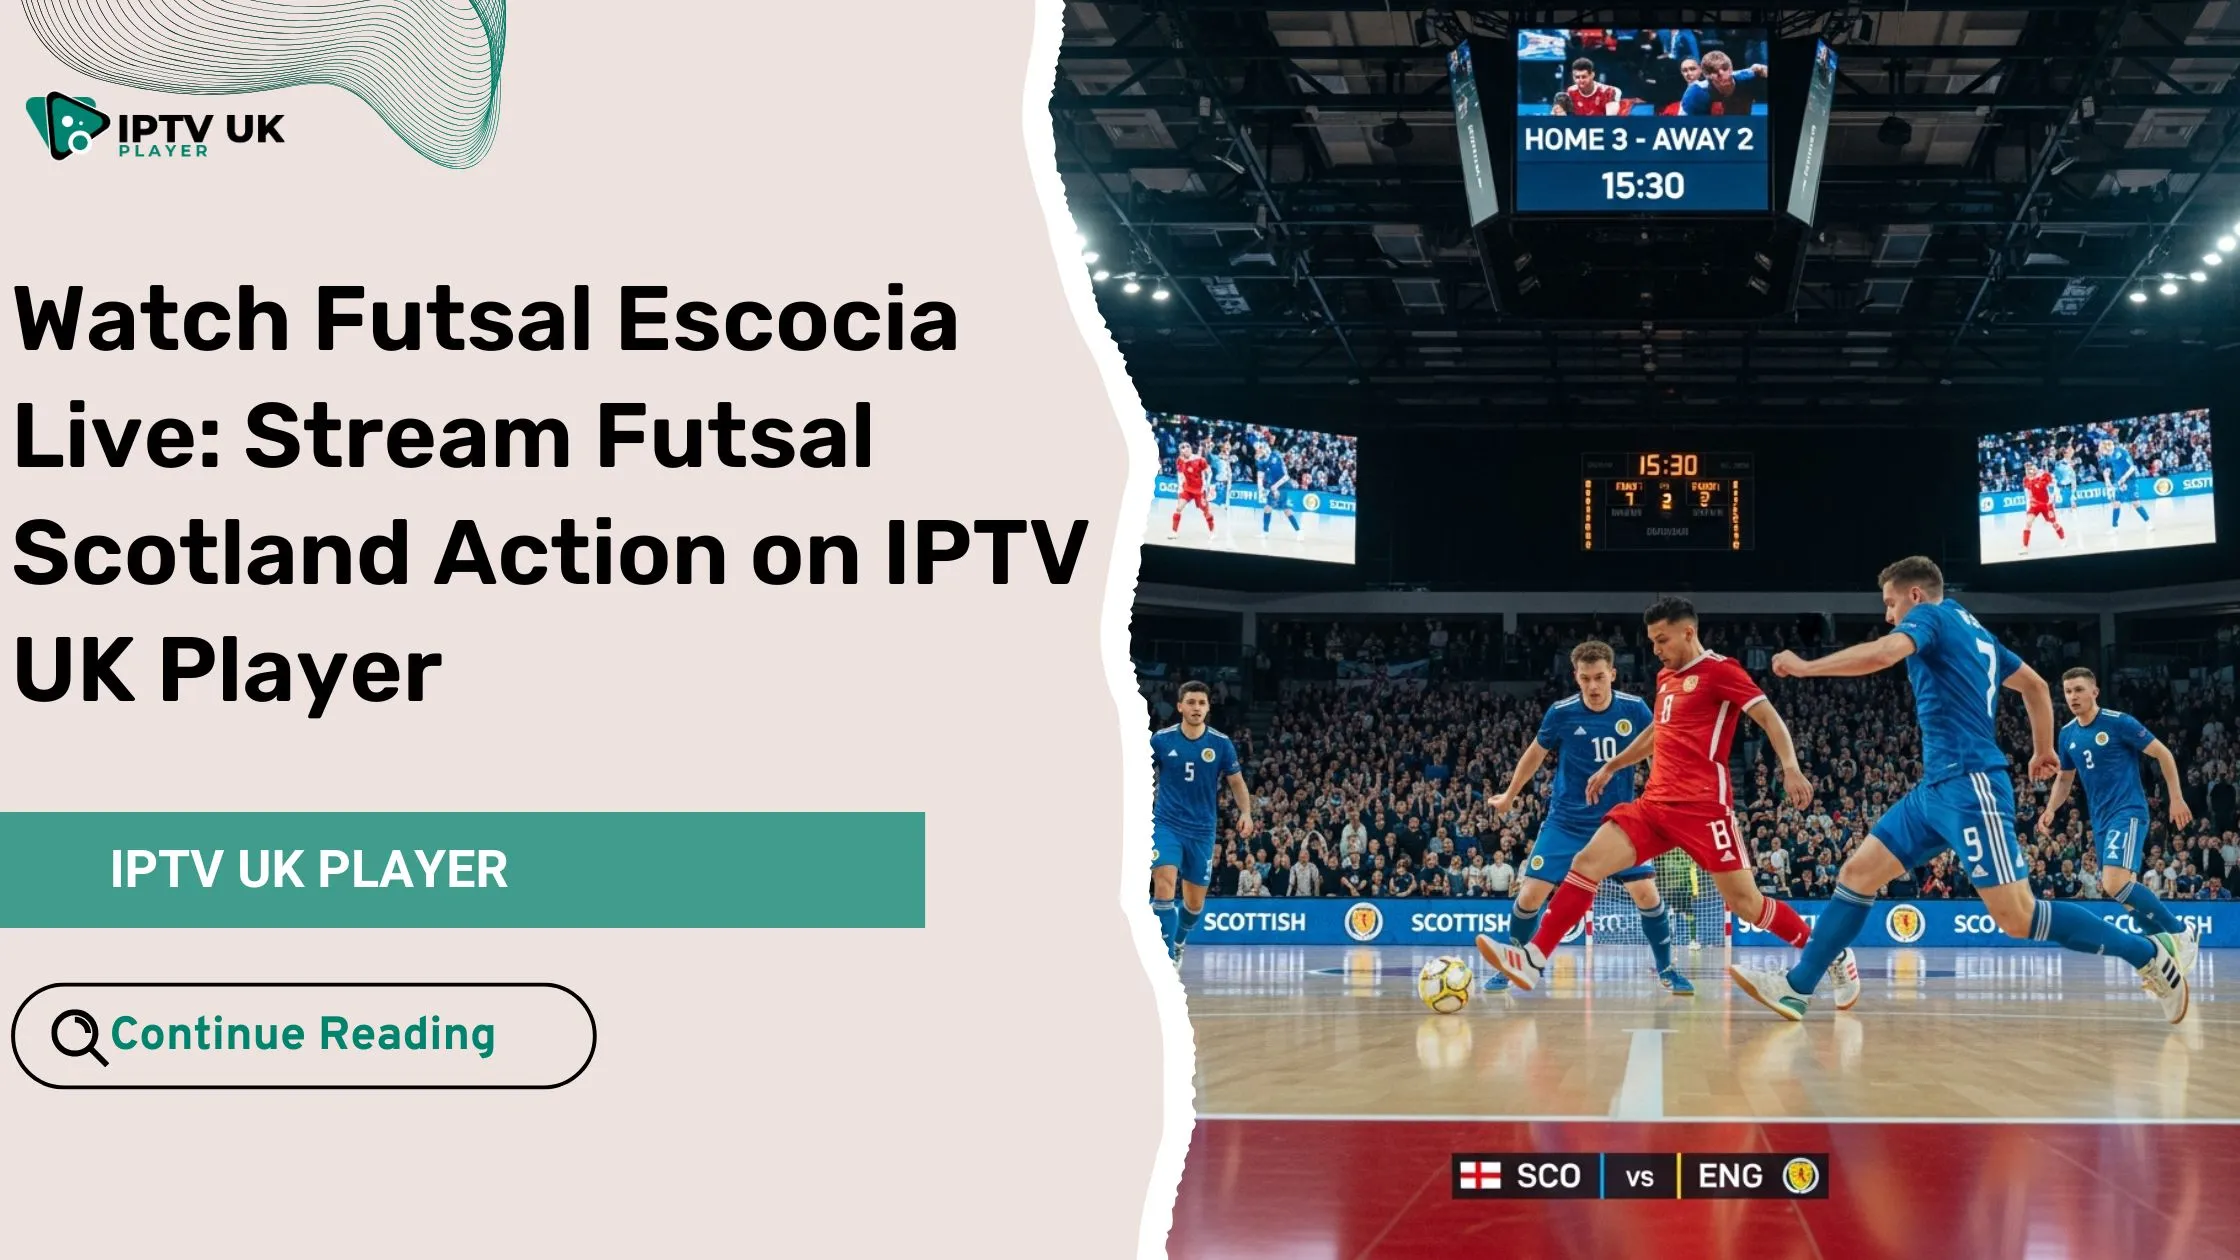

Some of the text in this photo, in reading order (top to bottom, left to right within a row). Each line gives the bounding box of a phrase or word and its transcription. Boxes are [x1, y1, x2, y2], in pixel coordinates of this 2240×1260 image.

[1525, 127, 1605, 151] HOME
[1611, 127, 1628, 151] 3
[1652, 127, 1731, 151] AWAY
[1737, 127, 1754, 151] 2
[1601, 171, 1685, 200] 15:30
[1640, 454, 1698, 476] 15:30
[1975, 636, 1997, 719] 7
[1660, 694, 1675, 724] 8
[1591, 736, 1617, 763] 10
[2082, 749, 2095, 769] 3
[1184, 761, 1195, 782] 5
[1963, 826, 1984, 863] 9
[1203, 912, 1306, 931] SCOTTISH
[1411, 913, 1511, 932] SCOTTISH
